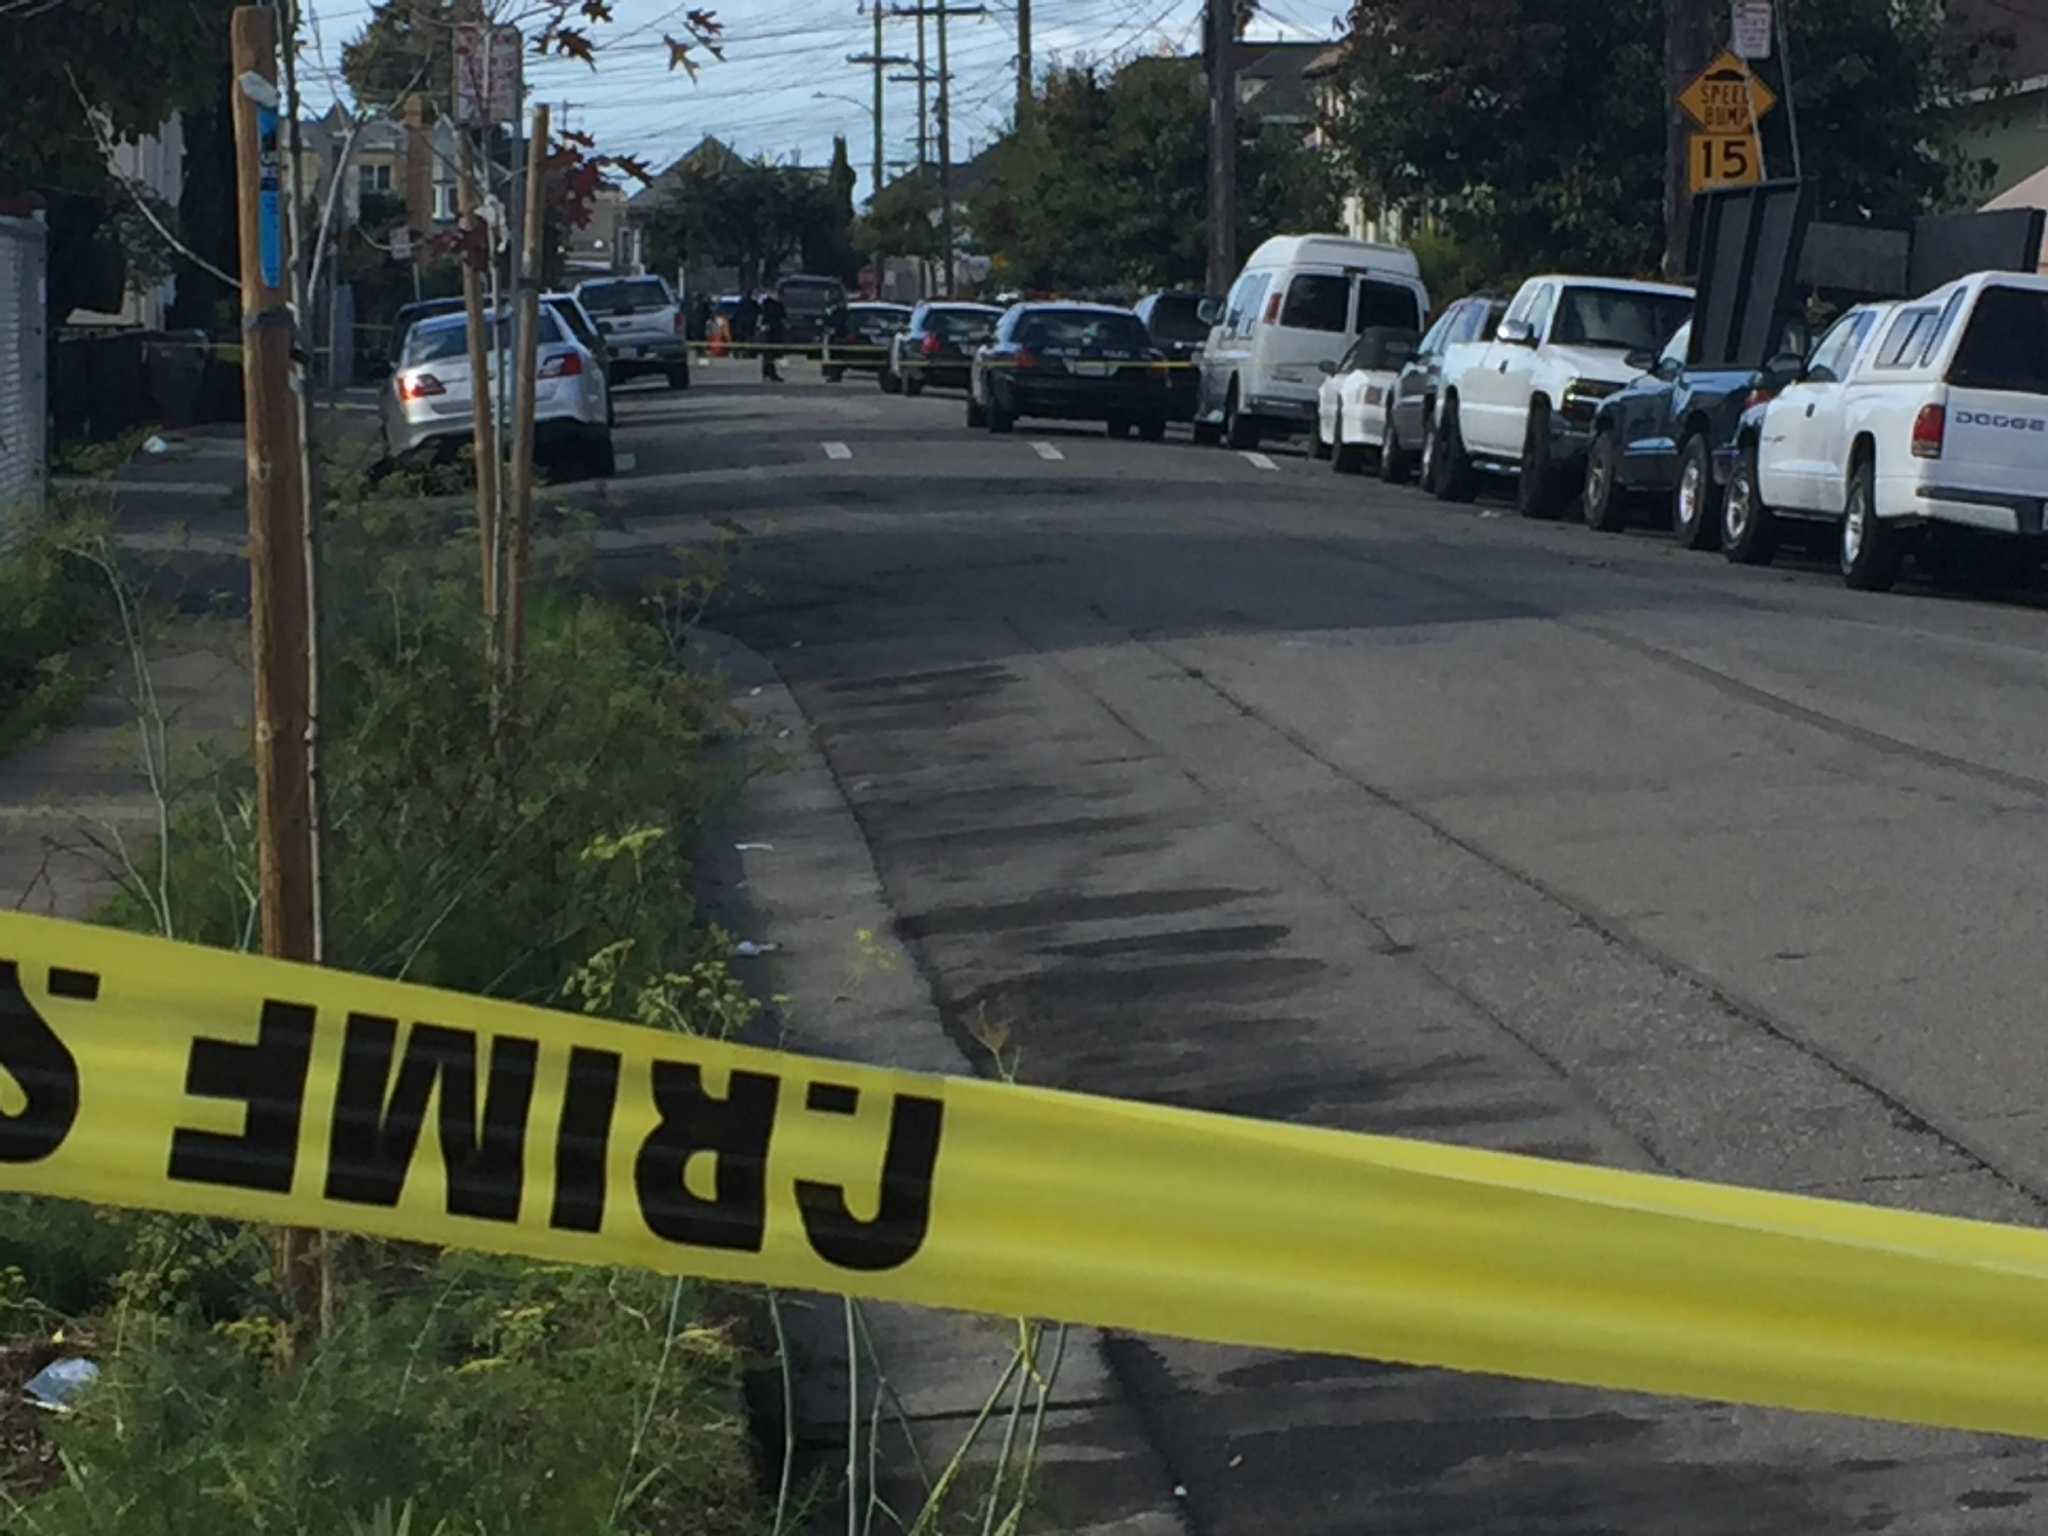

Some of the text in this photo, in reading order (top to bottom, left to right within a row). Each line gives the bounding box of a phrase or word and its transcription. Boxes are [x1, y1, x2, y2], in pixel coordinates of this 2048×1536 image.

[1705, 106, 1749, 126] BUMP
[1702, 140, 1748, 179] 15
[1955, 411, 2045, 432] DODGE
[168, 999, 945, 1271] CRIME
